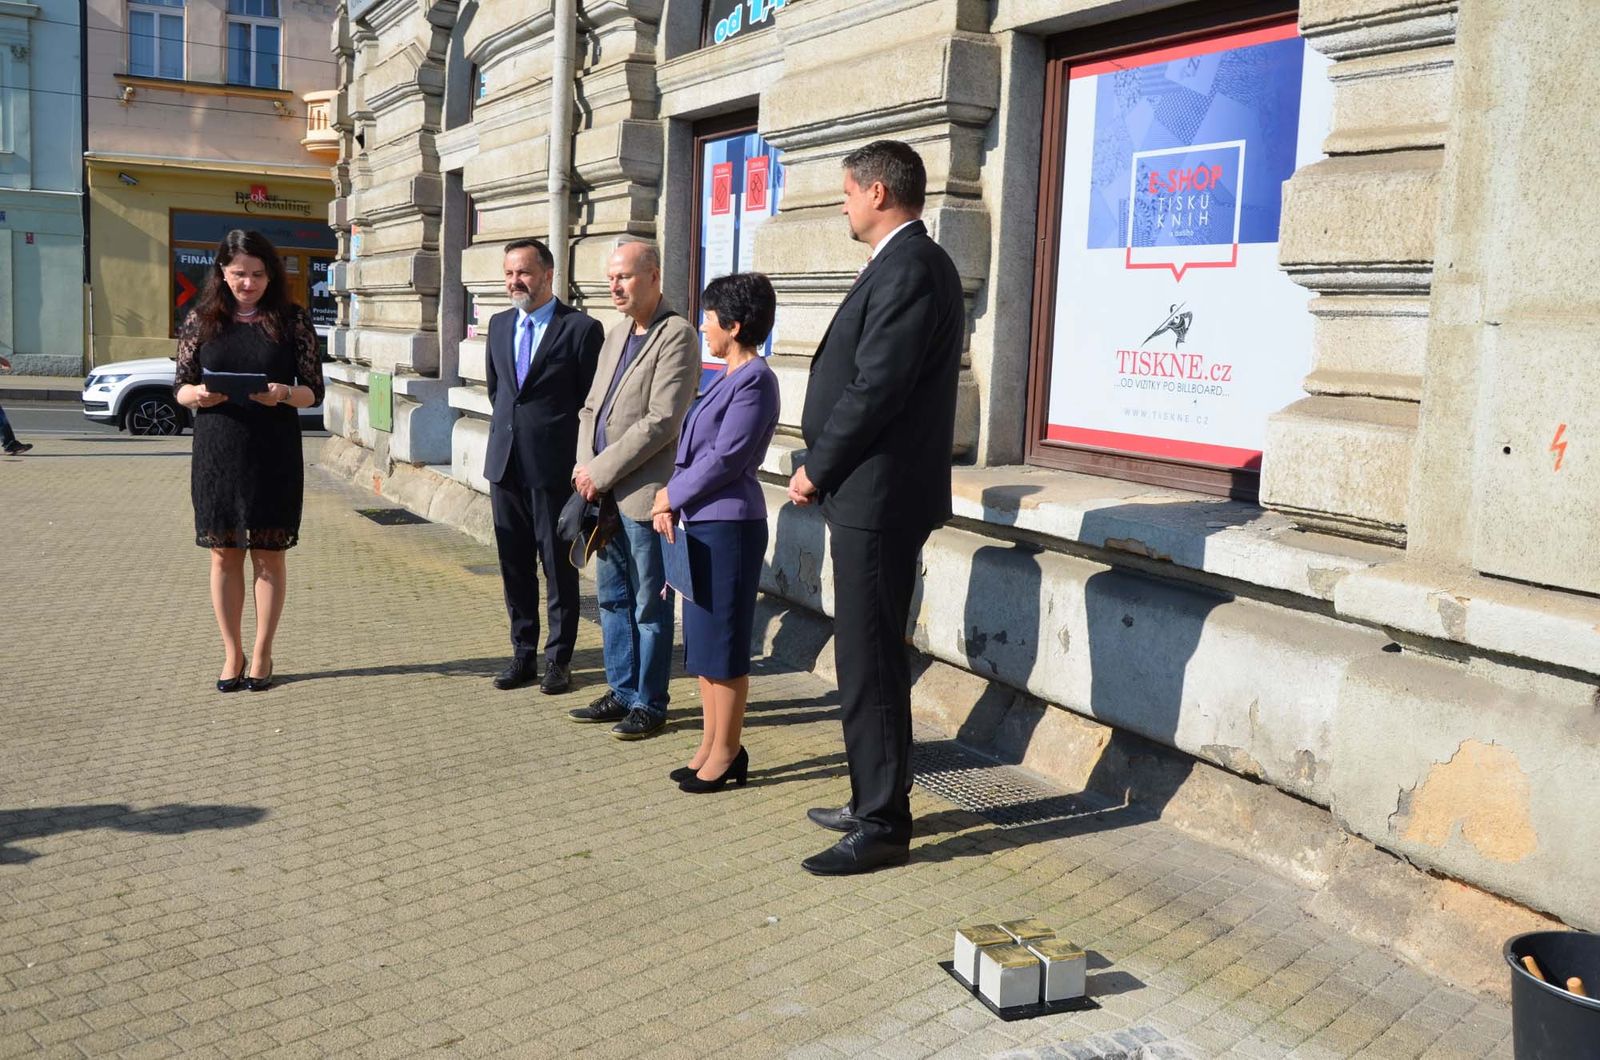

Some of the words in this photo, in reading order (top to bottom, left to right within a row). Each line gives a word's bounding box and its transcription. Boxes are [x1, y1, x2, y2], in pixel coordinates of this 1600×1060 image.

[714, 3, 743, 44] od
[1149, 165, 1222, 193] E-SHOP
[235, 188, 278, 204] Broker
[1158, 194, 1210, 211] TISKU
[244, 200, 311, 216] Consulting
[1157, 212, 1208, 228] KNIH
[1116, 350, 1233, 382] TISKNE.cz
[1135, 379, 1161, 391] VIZITKY
[1163, 381, 1176, 392] PO
